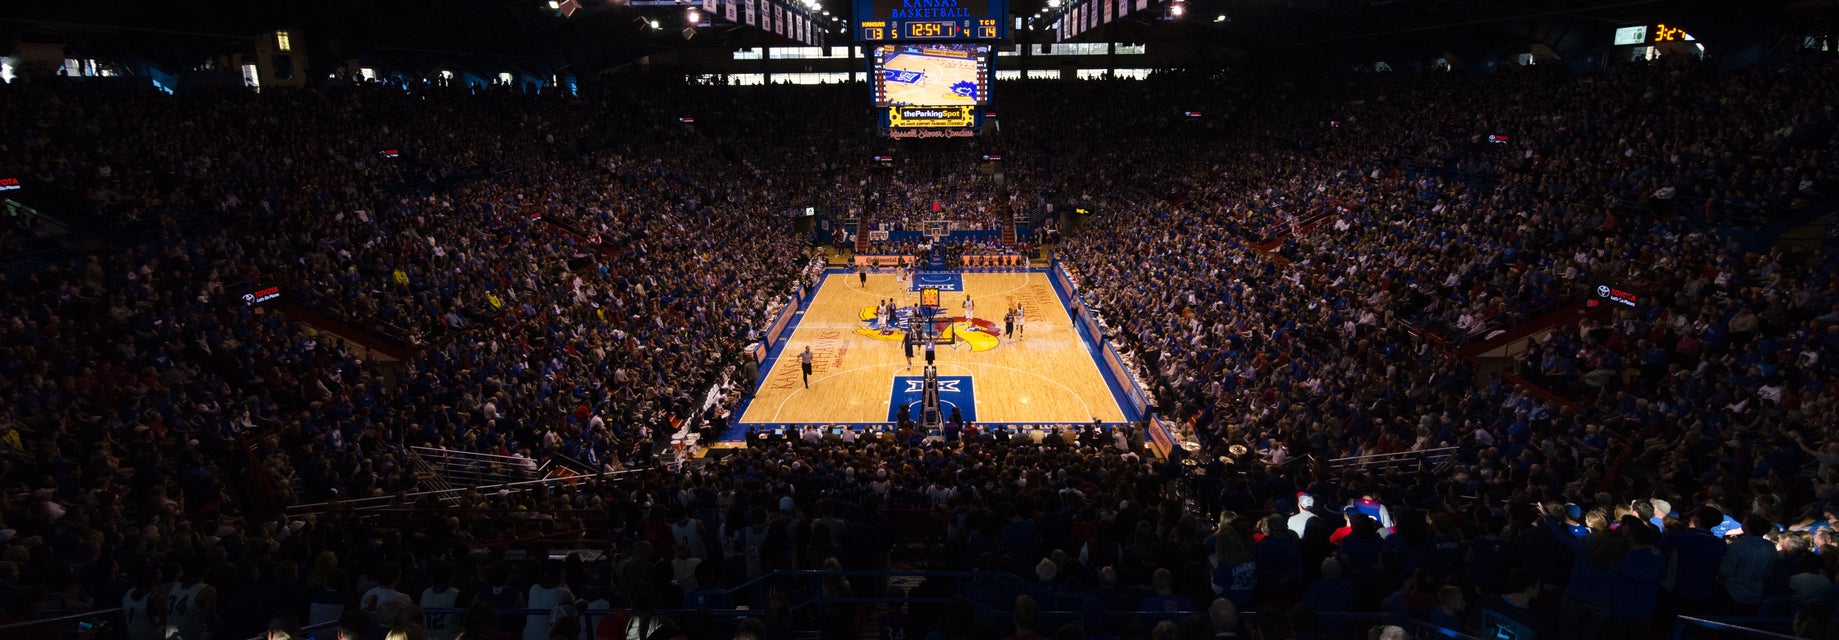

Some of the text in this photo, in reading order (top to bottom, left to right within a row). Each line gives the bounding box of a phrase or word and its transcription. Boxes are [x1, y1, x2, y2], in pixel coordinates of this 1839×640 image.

[892, 8, 970, 18] BASKETBALL
[872, 29, 883, 39] 13
[891, 28, 898, 39] 5
[912, 23, 941, 36] 12:54
[963, 28, 970, 37] 4
[985, 27, 996, 38] 14
[903, 110, 960, 119] theParkingSpot
[255, 285, 279, 298] TOYOTA
[1611, 287, 1637, 302] TOYOTA
[168, 594, 189, 616] 34
